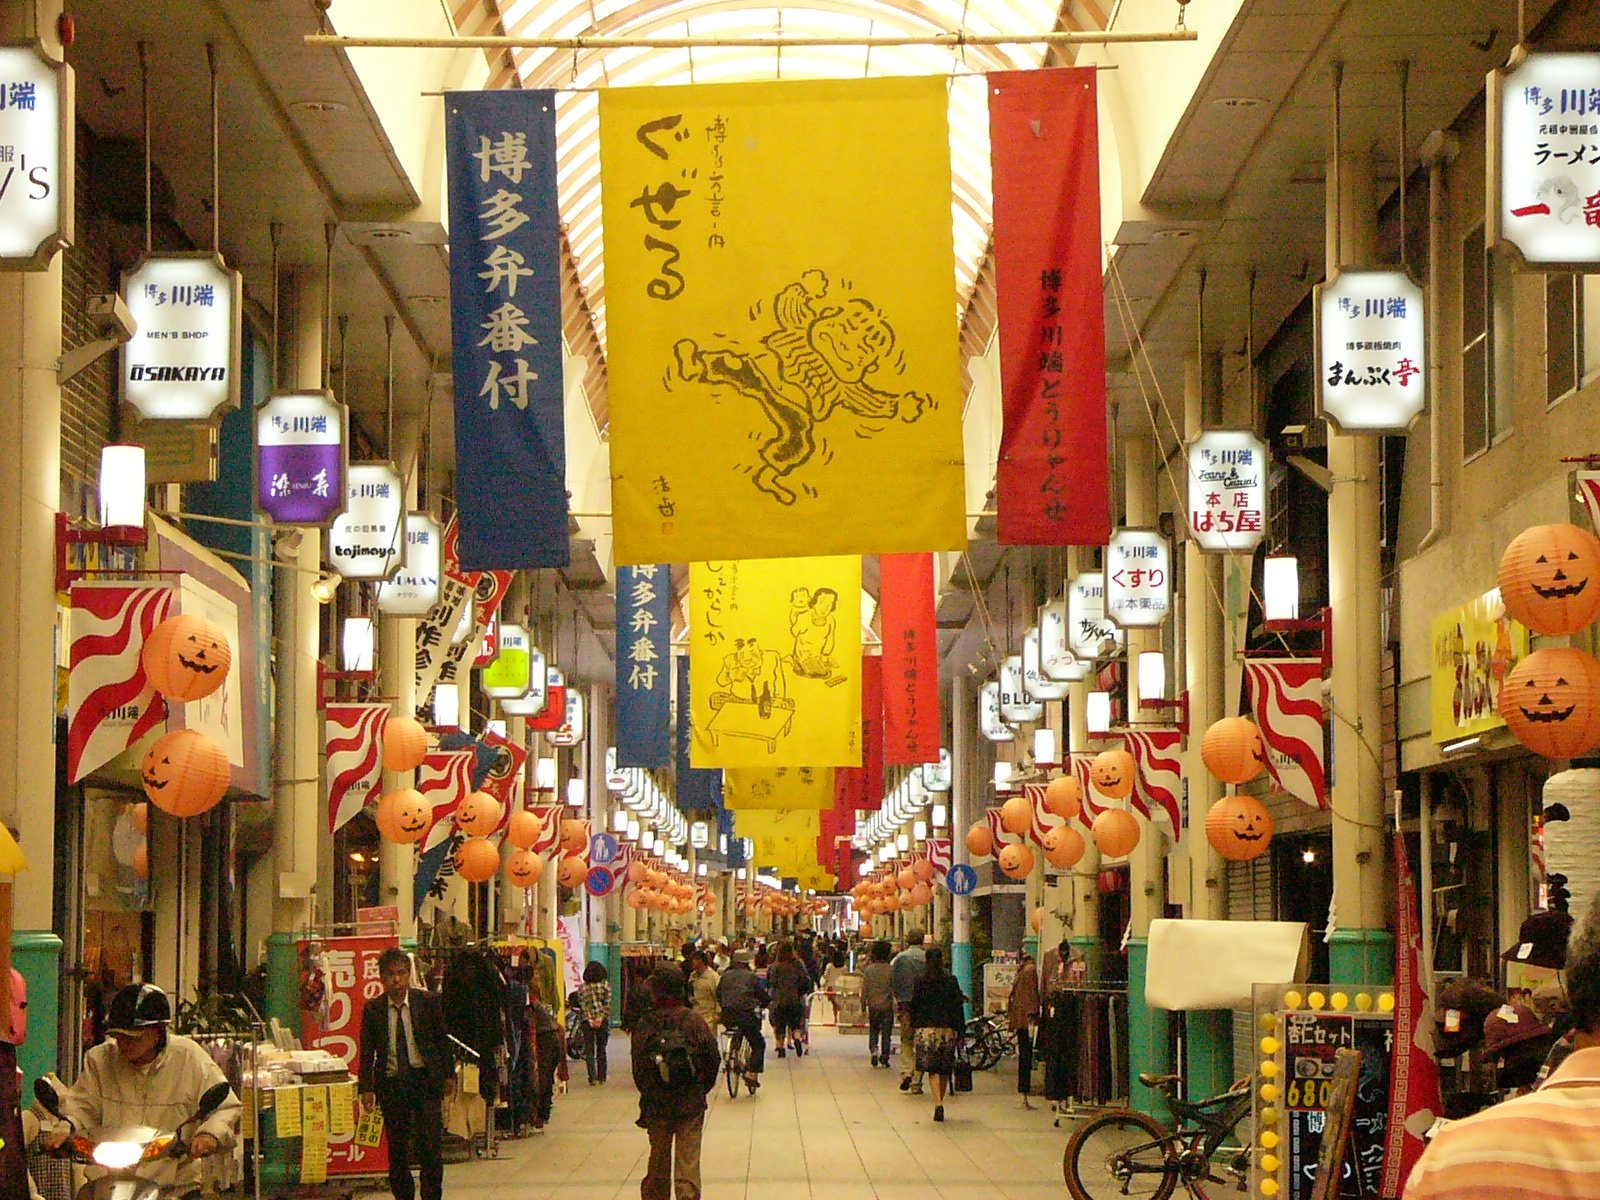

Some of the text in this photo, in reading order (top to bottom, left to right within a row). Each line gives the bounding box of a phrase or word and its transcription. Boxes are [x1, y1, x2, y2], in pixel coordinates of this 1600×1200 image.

[630, 114, 697, 300] ぐぜる
[472, 131, 538, 410] 博多弁番付
[144, 283, 215, 307] 博多川端
[1338, 296, 1407, 319] 博多川端
[146, 331, 178, 339] MEN'S
[1327, 357, 1421, 387] まんぷく亭
[270, 415, 328, 434] 博多川端
[1201, 448, 1253, 466] 博多川端
[1193, 510, 1261, 532] はち屋
[1112, 569, 1164, 588] くすり
